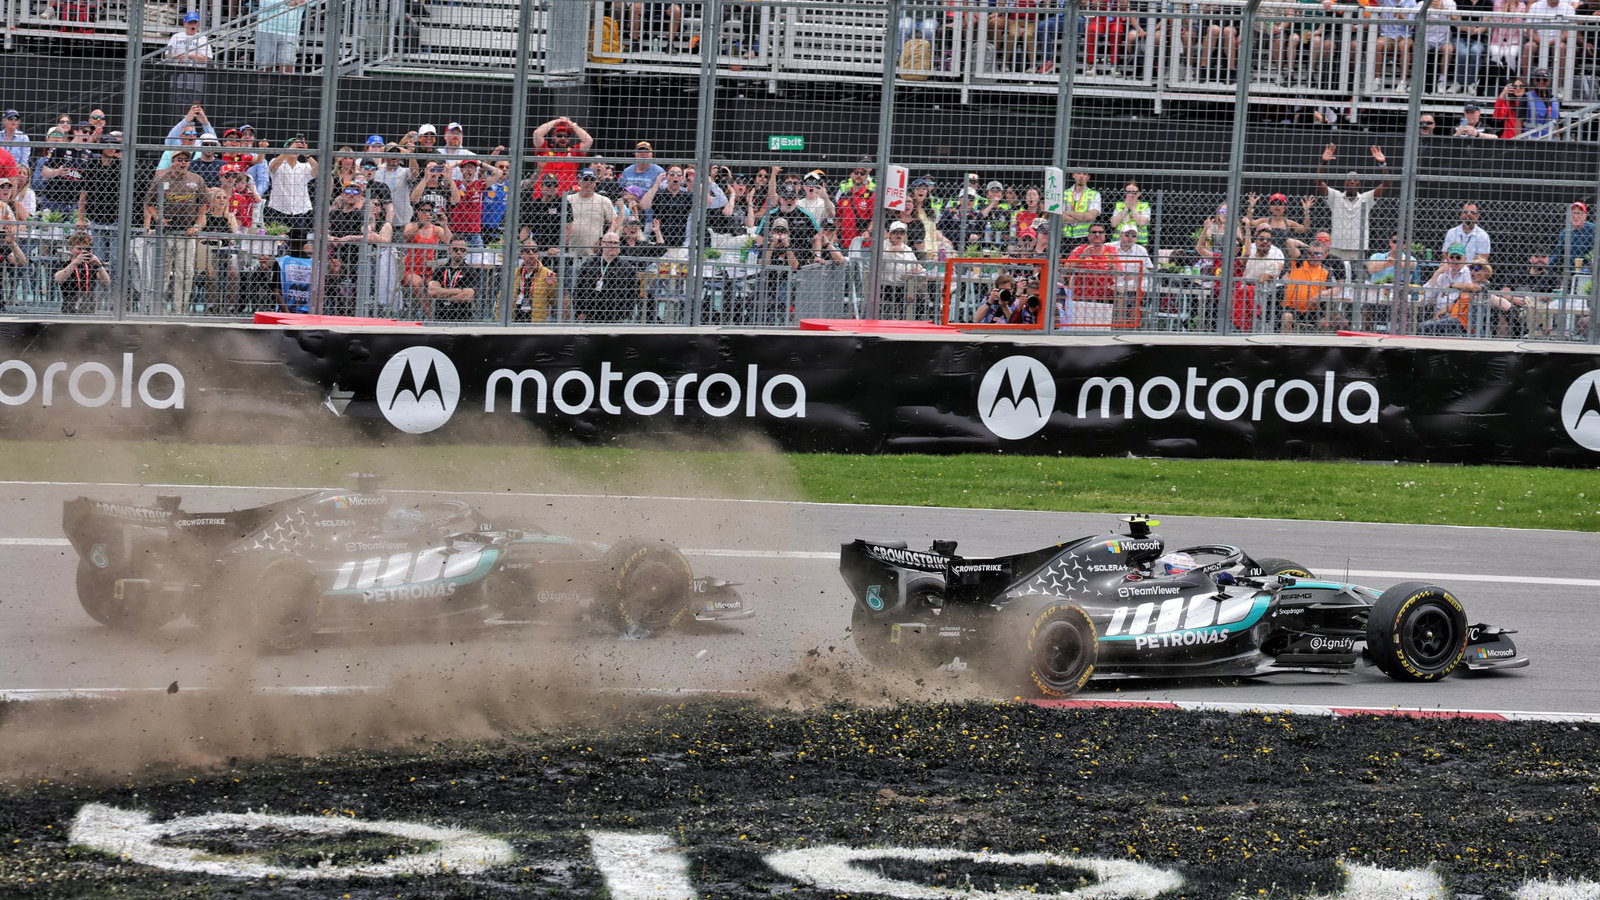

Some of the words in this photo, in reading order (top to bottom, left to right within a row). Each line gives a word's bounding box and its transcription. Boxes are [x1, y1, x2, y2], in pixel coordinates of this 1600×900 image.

[780, 137, 802, 146] Exit
[887, 187, 905, 198] FIRE
[1046, 192, 1061, 202] EXIT
[485, 362, 805, 417] motorola
[1078, 368, 1379, 423] motorola
[348, 495, 388, 505] Microsoft
[176, 518, 225, 526] CROWDSTRIKE
[1121, 540, 1160, 551] Microsoft
[955, 564, 1002, 573] CROWDSTRIKE
[1093, 564, 1123, 572] SOLERA
[362, 582, 457, 603] PETRONAS
[1129, 586, 1180, 596] TeamViewer
[1279, 608, 1304, 616] Snapdragon
[1135, 629, 1229, 650] PETRONAS
[1487, 648, 1514, 657] Microsoft
